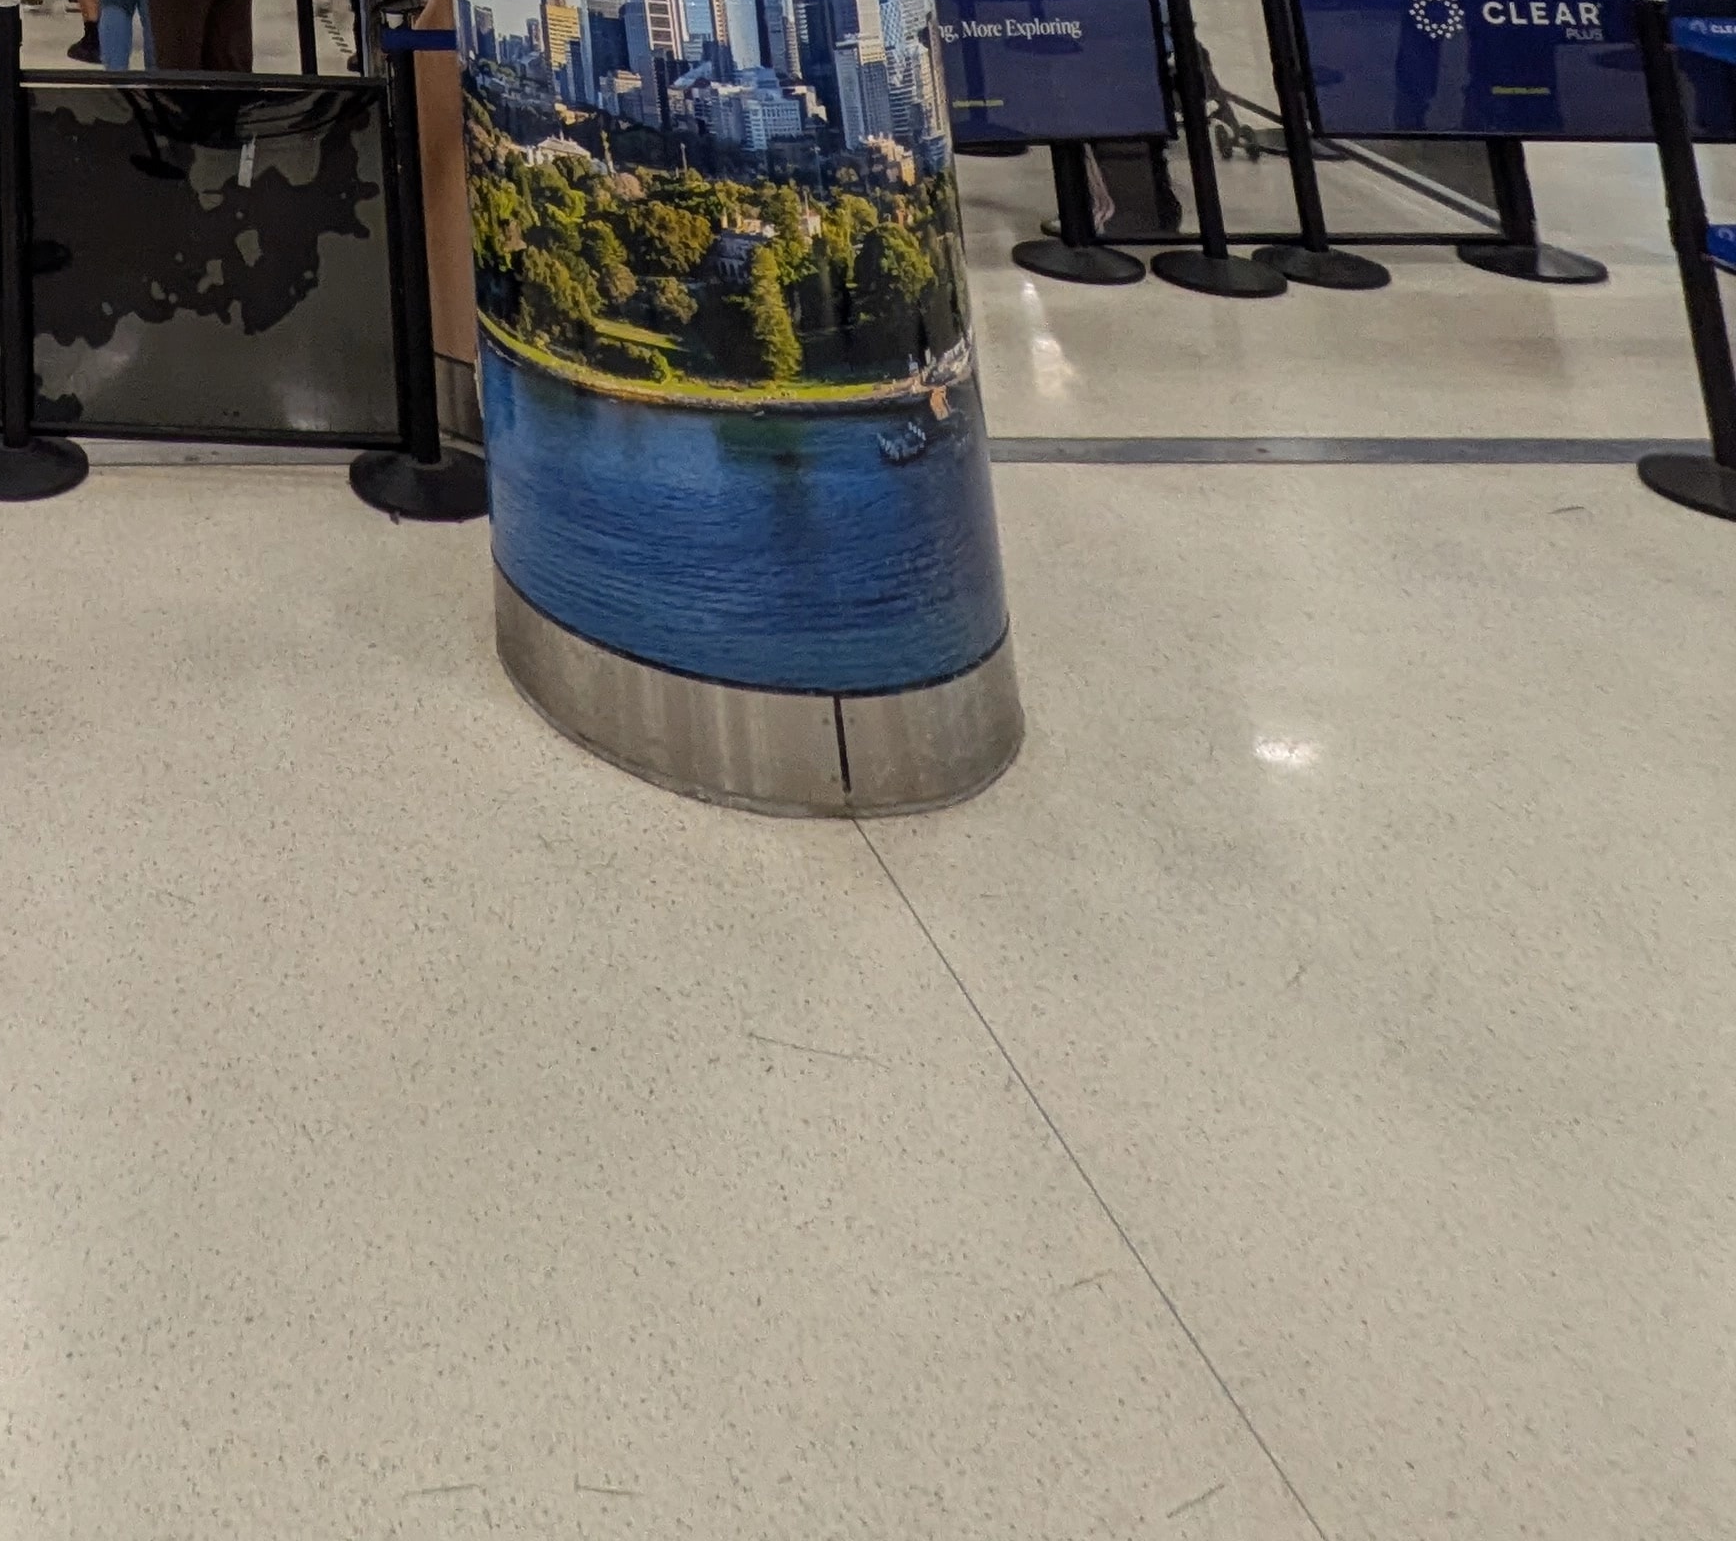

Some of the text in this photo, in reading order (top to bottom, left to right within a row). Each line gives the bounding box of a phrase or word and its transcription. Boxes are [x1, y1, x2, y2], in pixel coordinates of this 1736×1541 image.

[1482, 1, 1601, 26] CLEAR
[961, 21, 1002, 39] More
[1005, 17, 1083, 40] Exploring
[1566, 27, 1604, 41] PLUS
[1711, 24, 1736, 34] CLE
